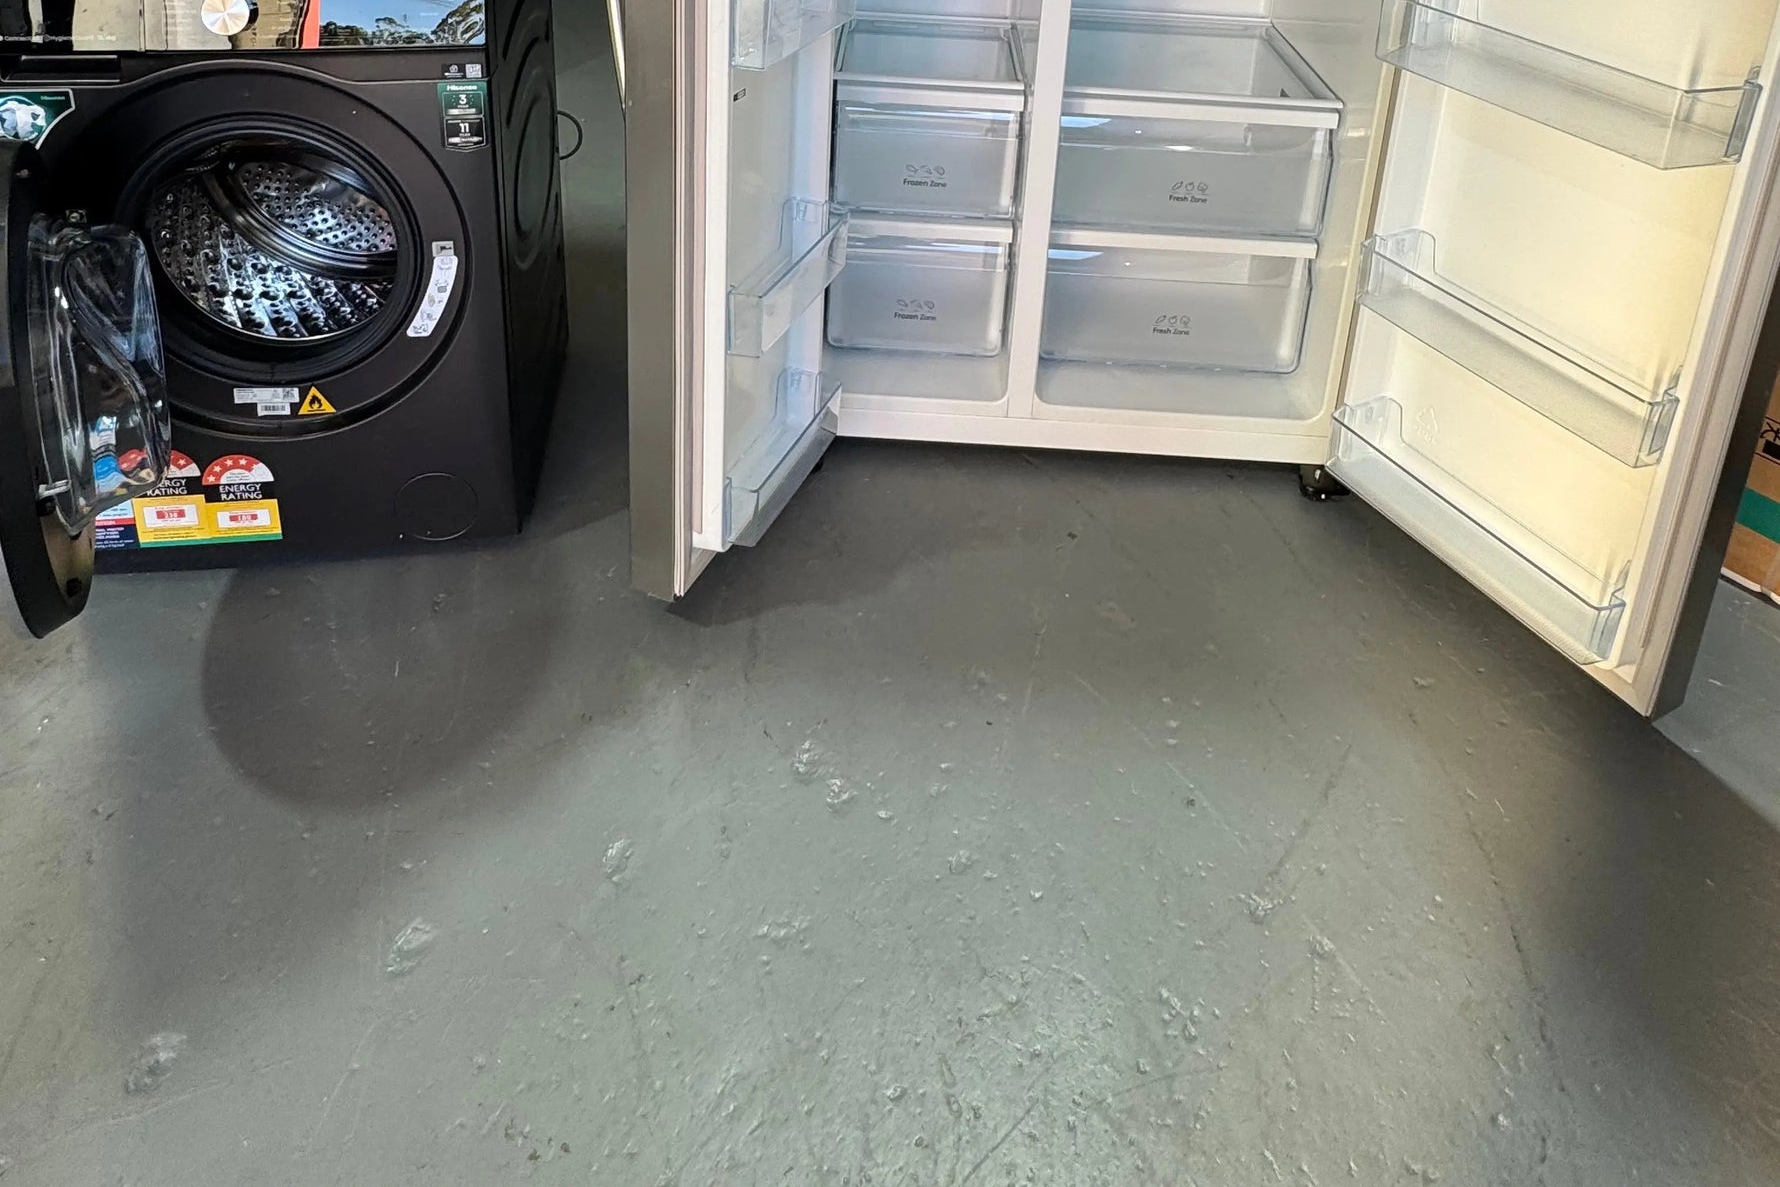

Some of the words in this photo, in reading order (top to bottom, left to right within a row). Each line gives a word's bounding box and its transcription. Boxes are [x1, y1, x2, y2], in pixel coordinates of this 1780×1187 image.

[459, 94, 467, 104] 3
[459, 123, 469, 133] 11
[903, 178, 929, 187] Frozen
[929, 180, 947, 188] Zone
[1169, 194, 1189, 202] Fresh
[894, 311, 919, 320] Frozen
[919, 313, 937, 321] Zone
[1152, 326, 1172, 334] Fresh
[218, 483, 261, 493] ENERGY
[220, 491, 263, 501] RATING
